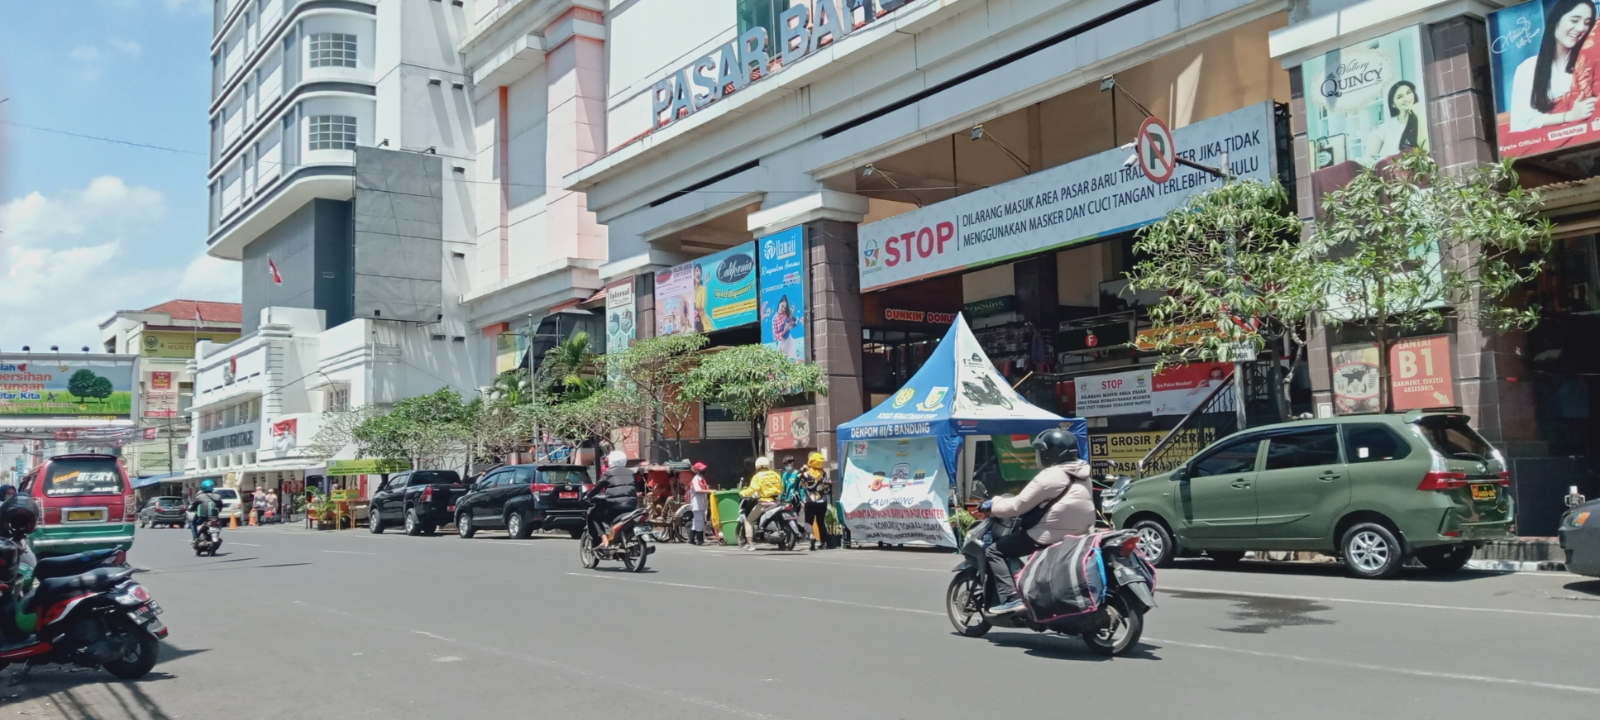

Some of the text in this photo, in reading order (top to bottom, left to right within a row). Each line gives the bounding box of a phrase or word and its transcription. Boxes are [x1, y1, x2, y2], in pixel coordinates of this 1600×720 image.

[652, 0, 898, 130] PASAR BAR
[1321, 67, 1383, 97] QUINCY
[1518, 137, 1541, 147] Official
[962, 205, 1003, 227] DILARANG
[1004, 200, 1034, 216] MASUK
[1035, 190, 1059, 207] AREA
[1060, 180, 1090, 201] PASAR
[1090, 172, 1118, 191] BARU
[1119, 164, 1147, 183] TRAD
[1199, 142, 1222, 163] JIKA
[1224, 130, 1261, 153] TIDAK
[963, 220, 1027, 247] MENGGUNAKAN
[1028, 211, 1065, 231] MASKER
[1066, 203, 1086, 222] DAN
[1087, 197, 1111, 215] CUCI
[1111, 185, 1155, 210] TANGAN
[1158, 171, 1207, 196] TERLEBIH
[884, 221, 954, 267] STOP
[717, 260, 753, 282] California
[885, 308, 925, 321] DUNKIN'
[1398, 338, 1431, 349] LANTAI
[1399, 348, 1434, 378] B1
[1101, 379, 1123, 390] STOP
[1393, 379, 1421, 387] GARMENT,
[1404, 385, 1434, 393] AKSESORIS
[20, 392, 41, 400] Kita
[772, 415, 785, 432] B1
[851, 425, 879, 438] DENPOM
[894, 422, 930, 435] BANDUNG
[1111, 435, 1151, 446] GROSIR
[1092, 443, 1107, 455] B1
[1113, 462, 1138, 472] PASA
[868, 496, 915, 507] LAUNCHING
[921, 508, 945, 519] CENTER
